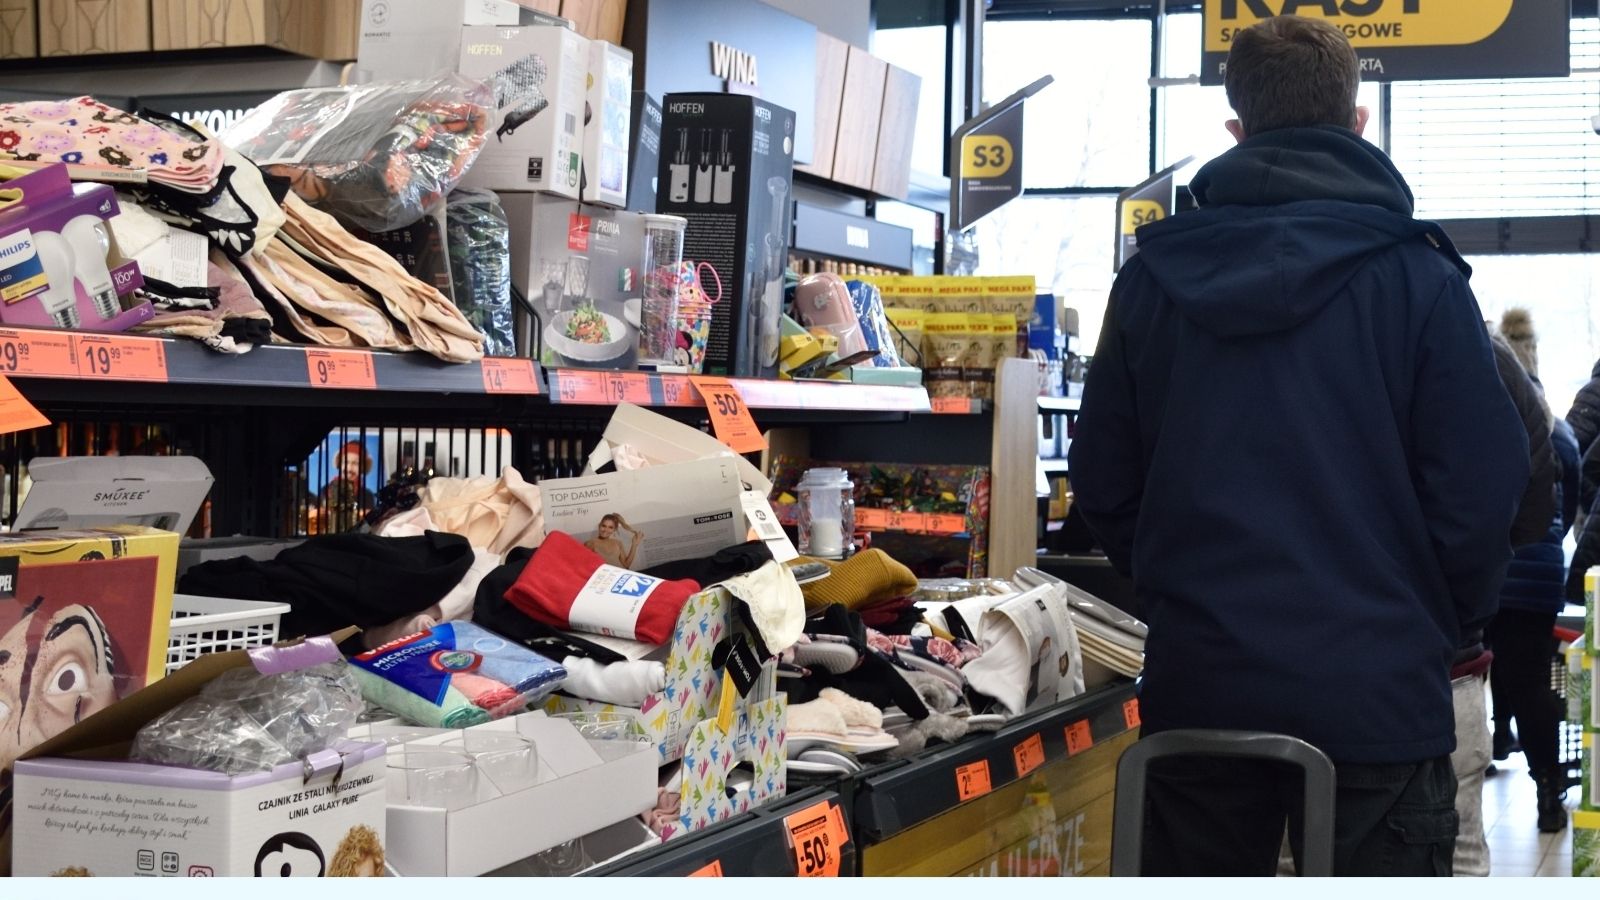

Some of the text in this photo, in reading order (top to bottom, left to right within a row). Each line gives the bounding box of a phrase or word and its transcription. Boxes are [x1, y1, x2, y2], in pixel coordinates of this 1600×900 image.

[467, 44, 503, 56] HOFFEN
[709, 40, 759, 87] WINA
[1358, 58, 1385, 74] RTĄ
[669, 102, 705, 115] HOFFEN
[973, 144, 1006, 169] S3
[1132, 208, 1158, 226] S4
[0, 273, 13, 284] LED
[18, 343, 30, 355] 99
[86, 346, 111, 375] 19
[110, 347, 121, 360] 99
[317, 360, 328, 384] 9
[611, 380, 624, 401] 79
[550, 488, 608, 502] TOP DAMSKI
[962, 775, 970, 795] 2
[258, 796, 292, 812] CZAJNIK
[292, 792, 304, 803] ZE
[304, 788, 325, 800] STALI
[289, 794, 360, 820] LINIA GALAXY PURE
